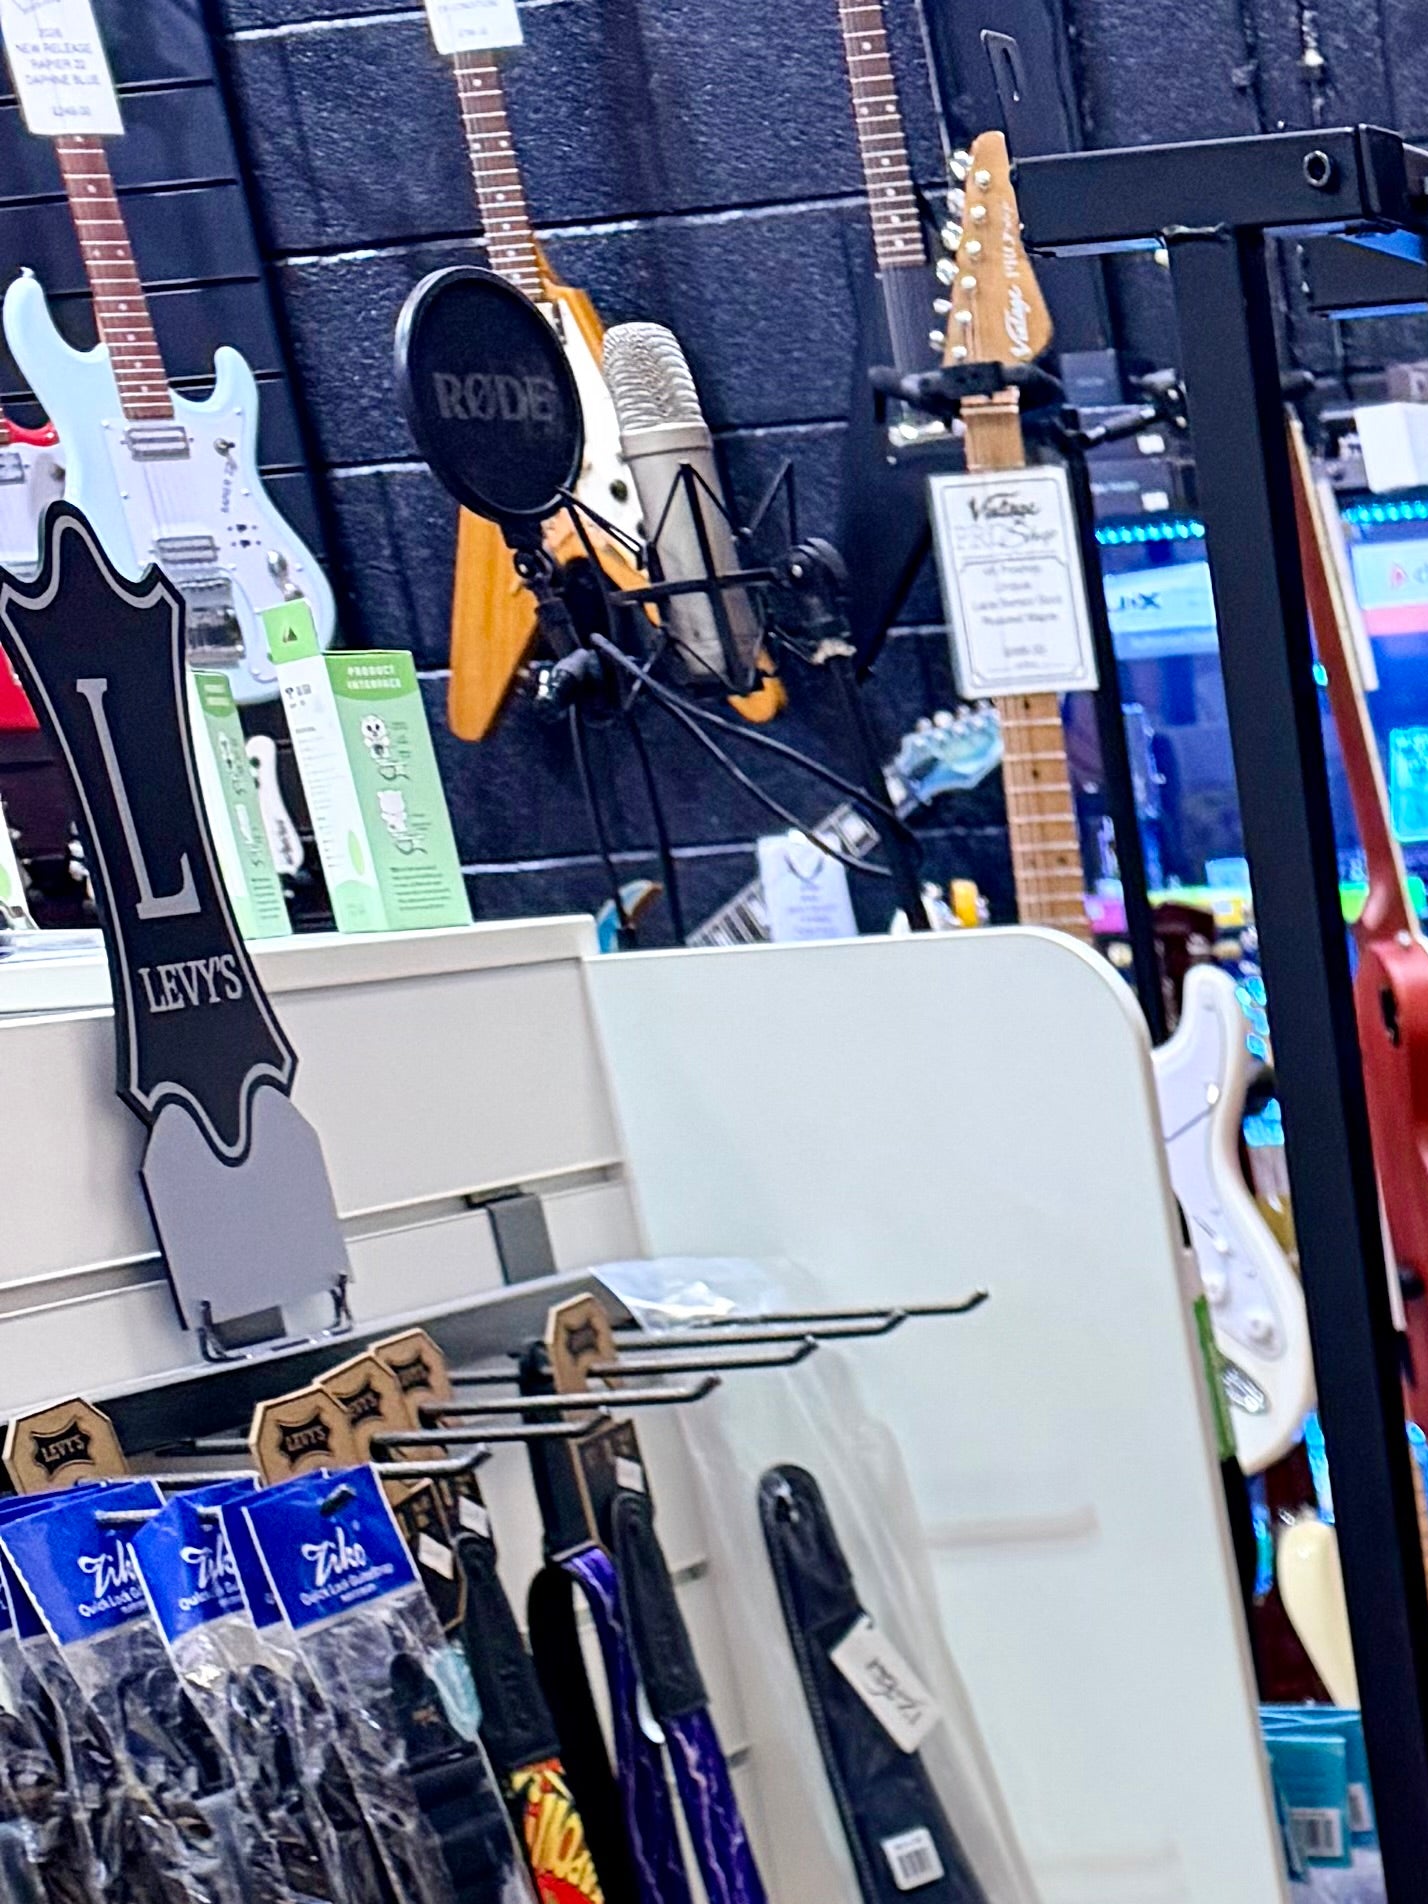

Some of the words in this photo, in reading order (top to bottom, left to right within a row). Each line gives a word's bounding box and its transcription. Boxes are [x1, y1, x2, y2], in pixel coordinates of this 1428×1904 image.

[76, 678, 201, 920] L
[137, 953, 243, 1014] LEVY'S
[41, 1435, 87, 1464] LEVY'S
